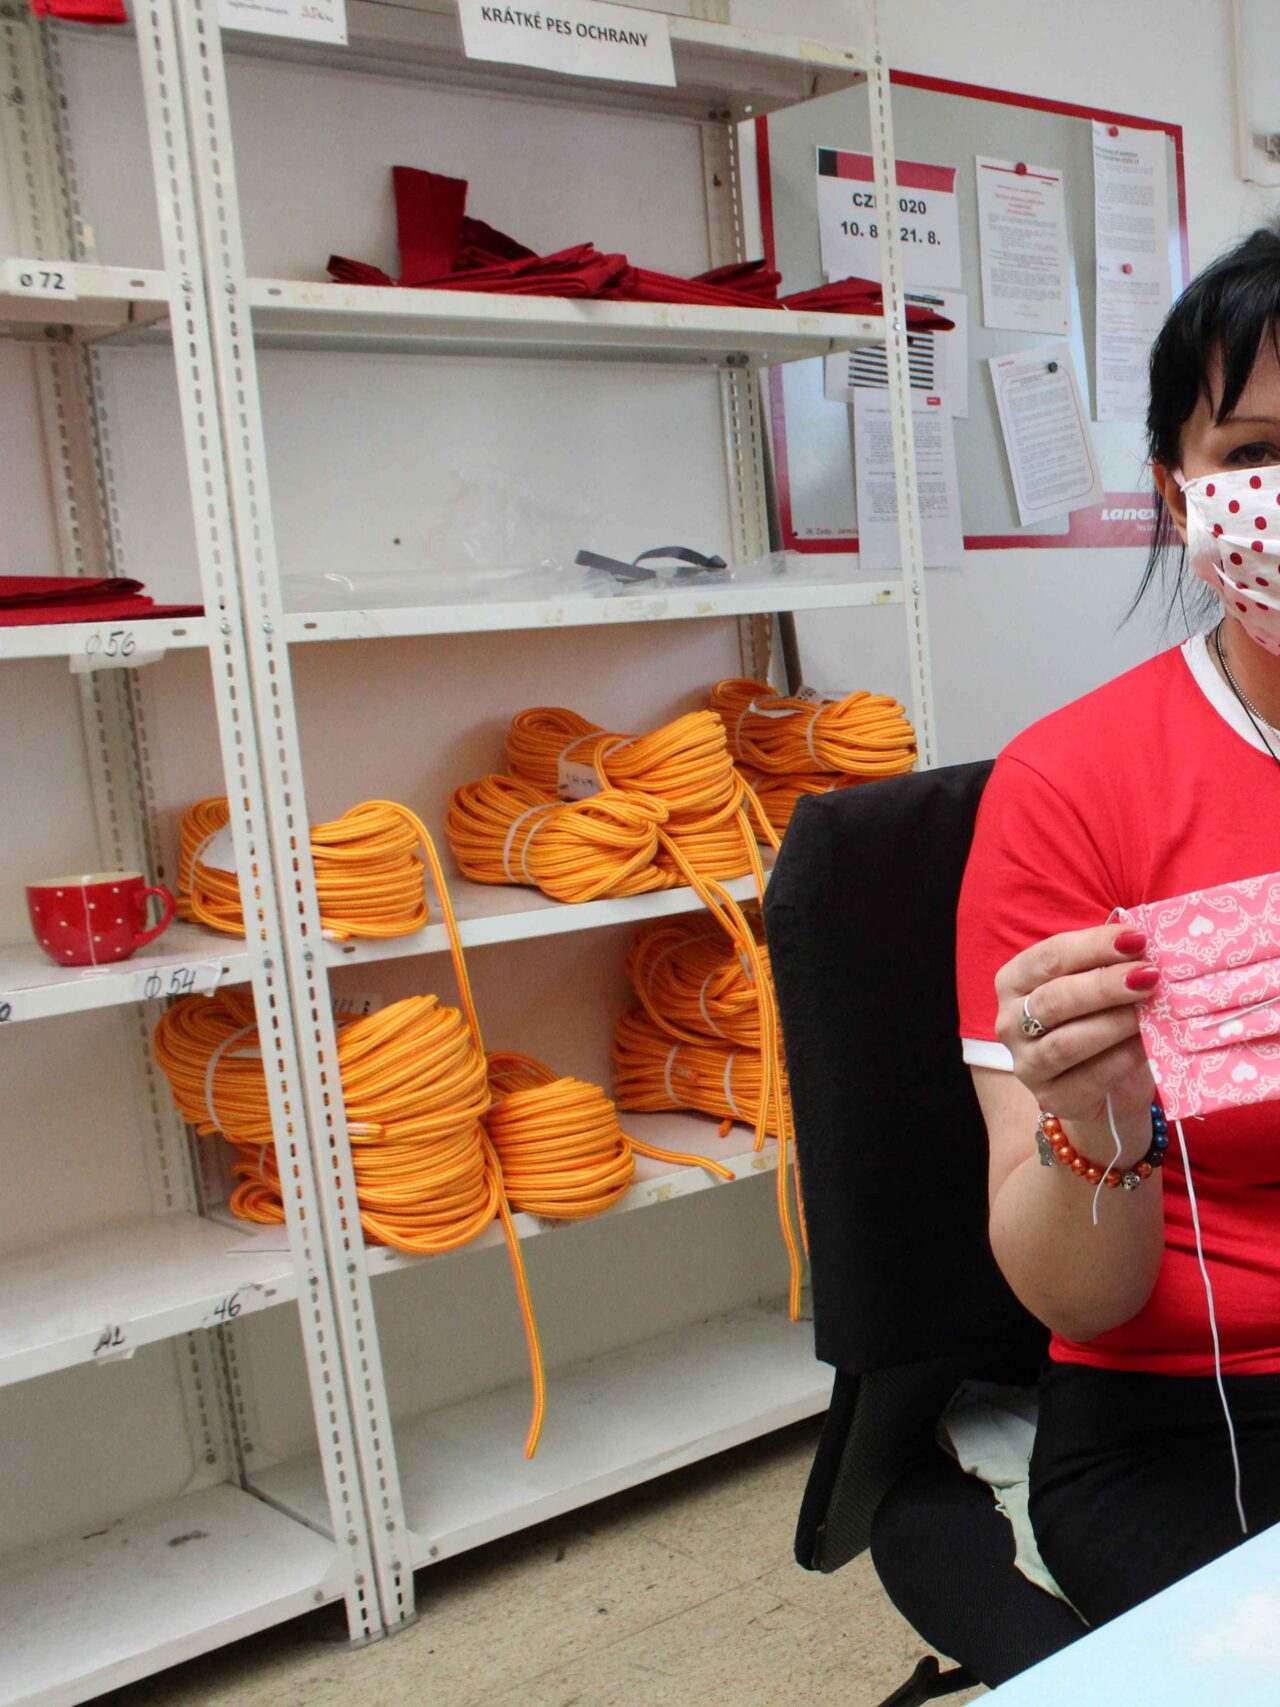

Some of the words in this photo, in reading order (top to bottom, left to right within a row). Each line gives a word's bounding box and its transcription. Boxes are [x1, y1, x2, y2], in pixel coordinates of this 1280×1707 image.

[481, 6, 542, 30] KRÁTKÉ
[546, 17, 572, 35] PES
[576, 23, 648, 47] OCHRANY
[899, 199, 927, 215] 020
[841, 221, 864, 237] 10.
[899, 228, 923, 243] 21.
[927, 231, 941, 245] 8.
[38, 271, 65, 290] 72
[104, 630, 136, 657] 56
[214, 1292, 241, 1319] 46
